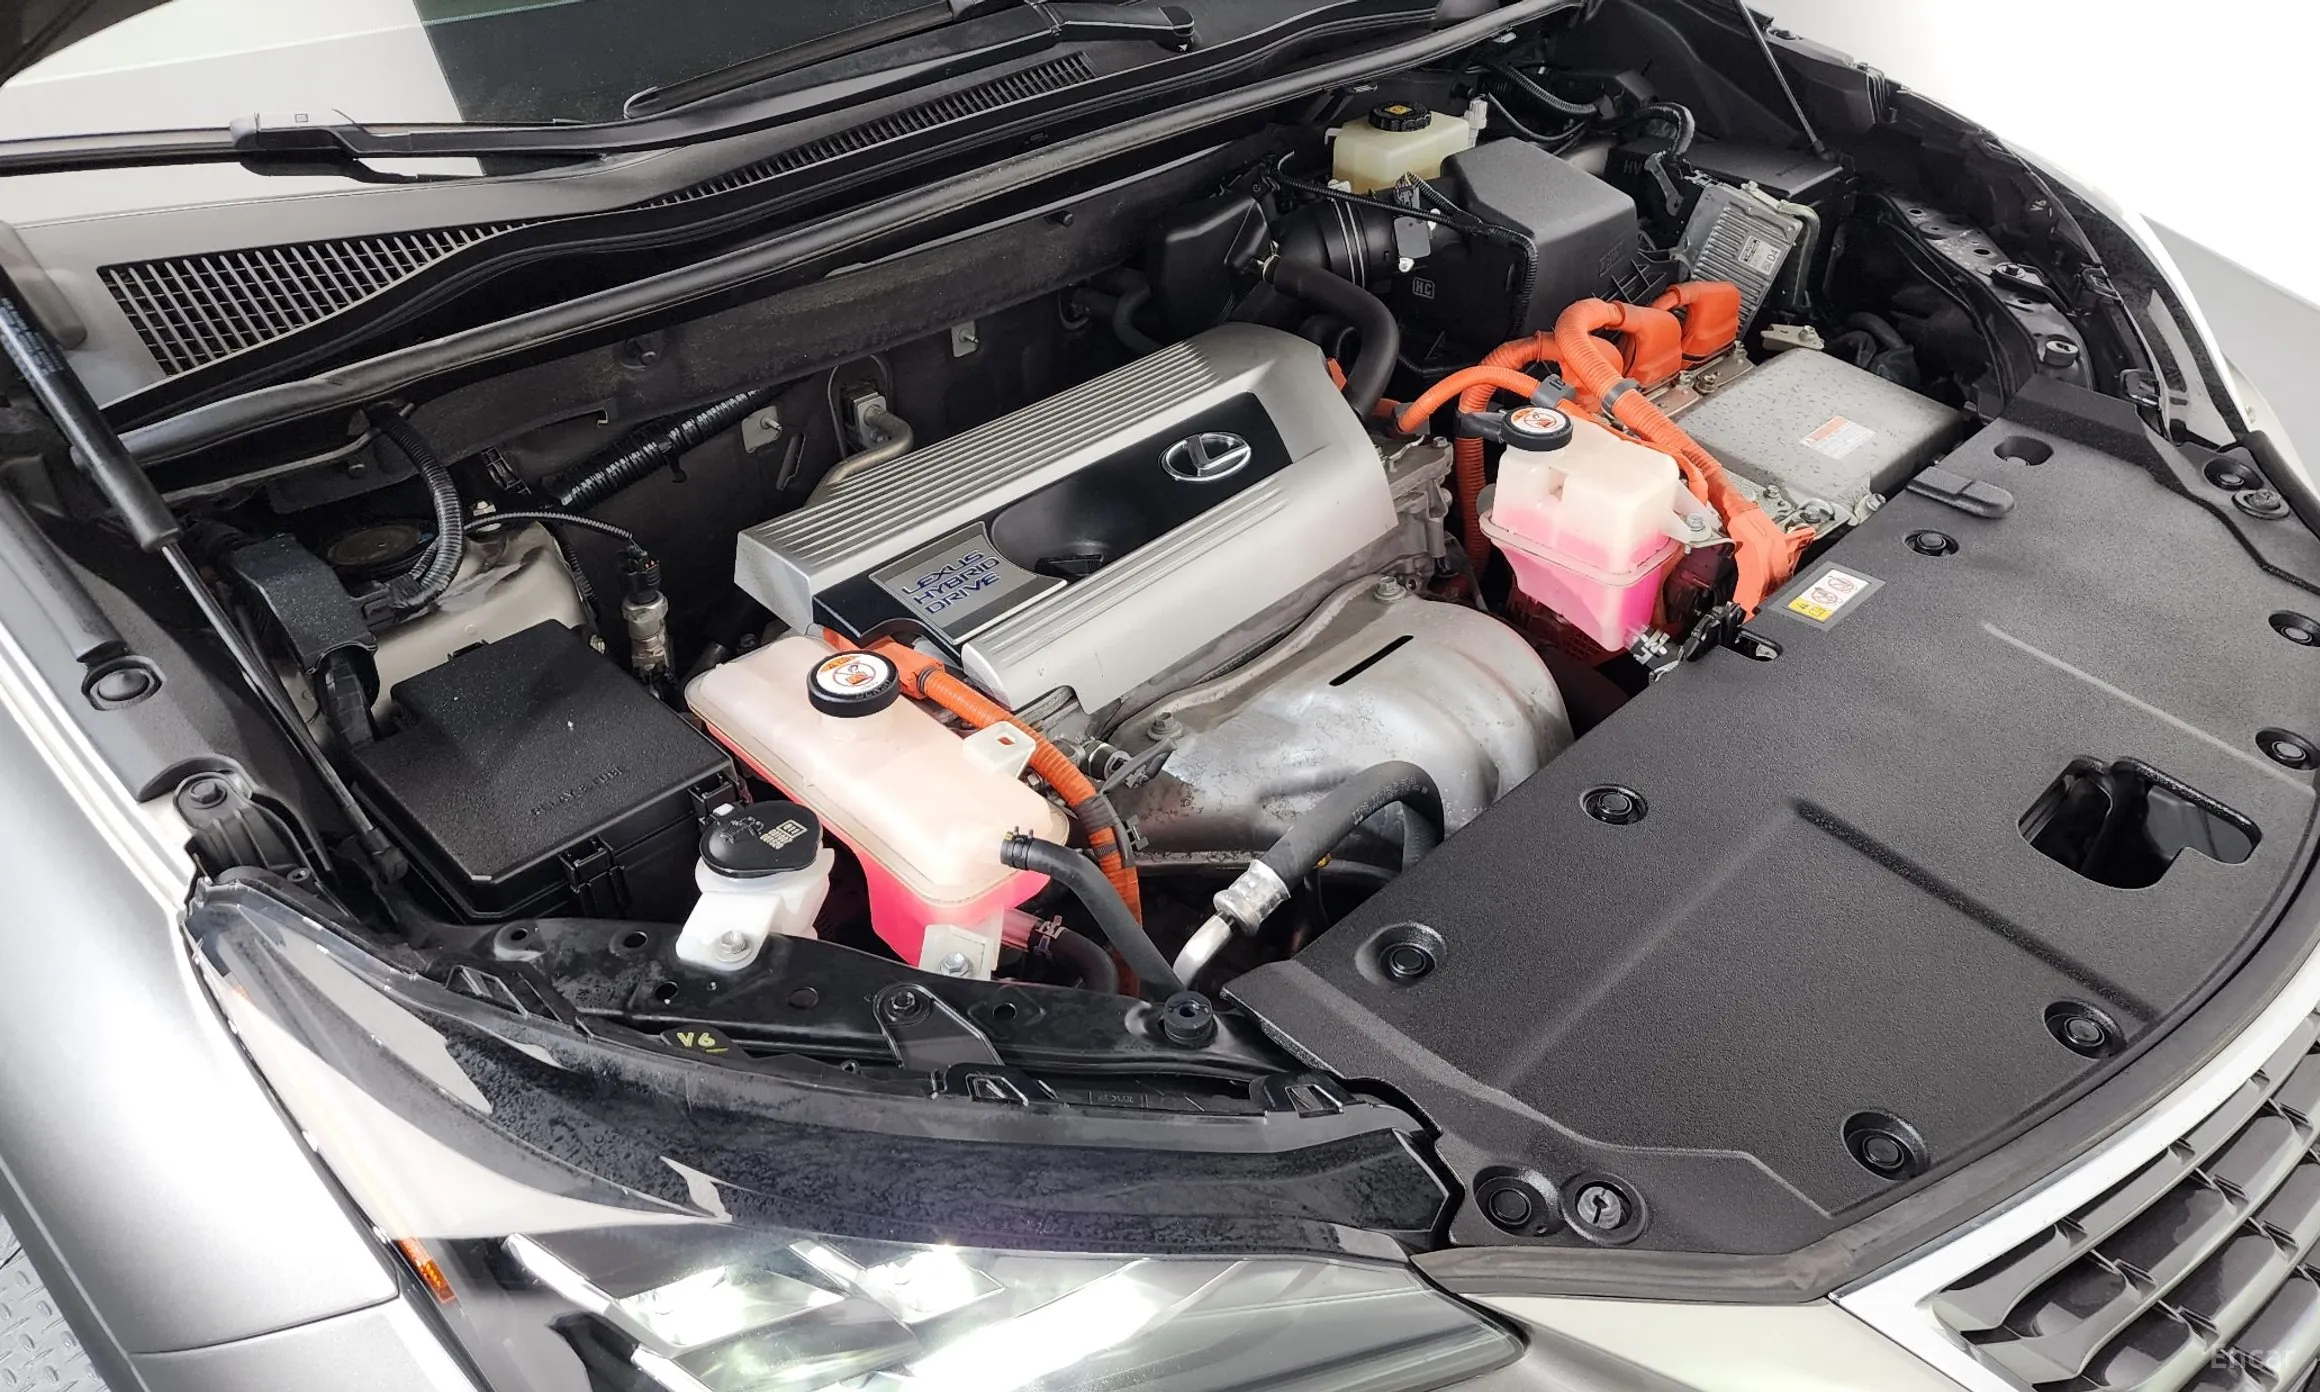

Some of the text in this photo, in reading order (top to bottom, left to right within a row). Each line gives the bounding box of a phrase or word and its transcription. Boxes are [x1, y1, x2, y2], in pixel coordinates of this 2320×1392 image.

[901, 549, 985, 594] LEXUS
[913, 556, 1001, 604] HYBRID
[925, 571, 1002, 614] DRIVE
[676, 1032, 716, 1048] V6
